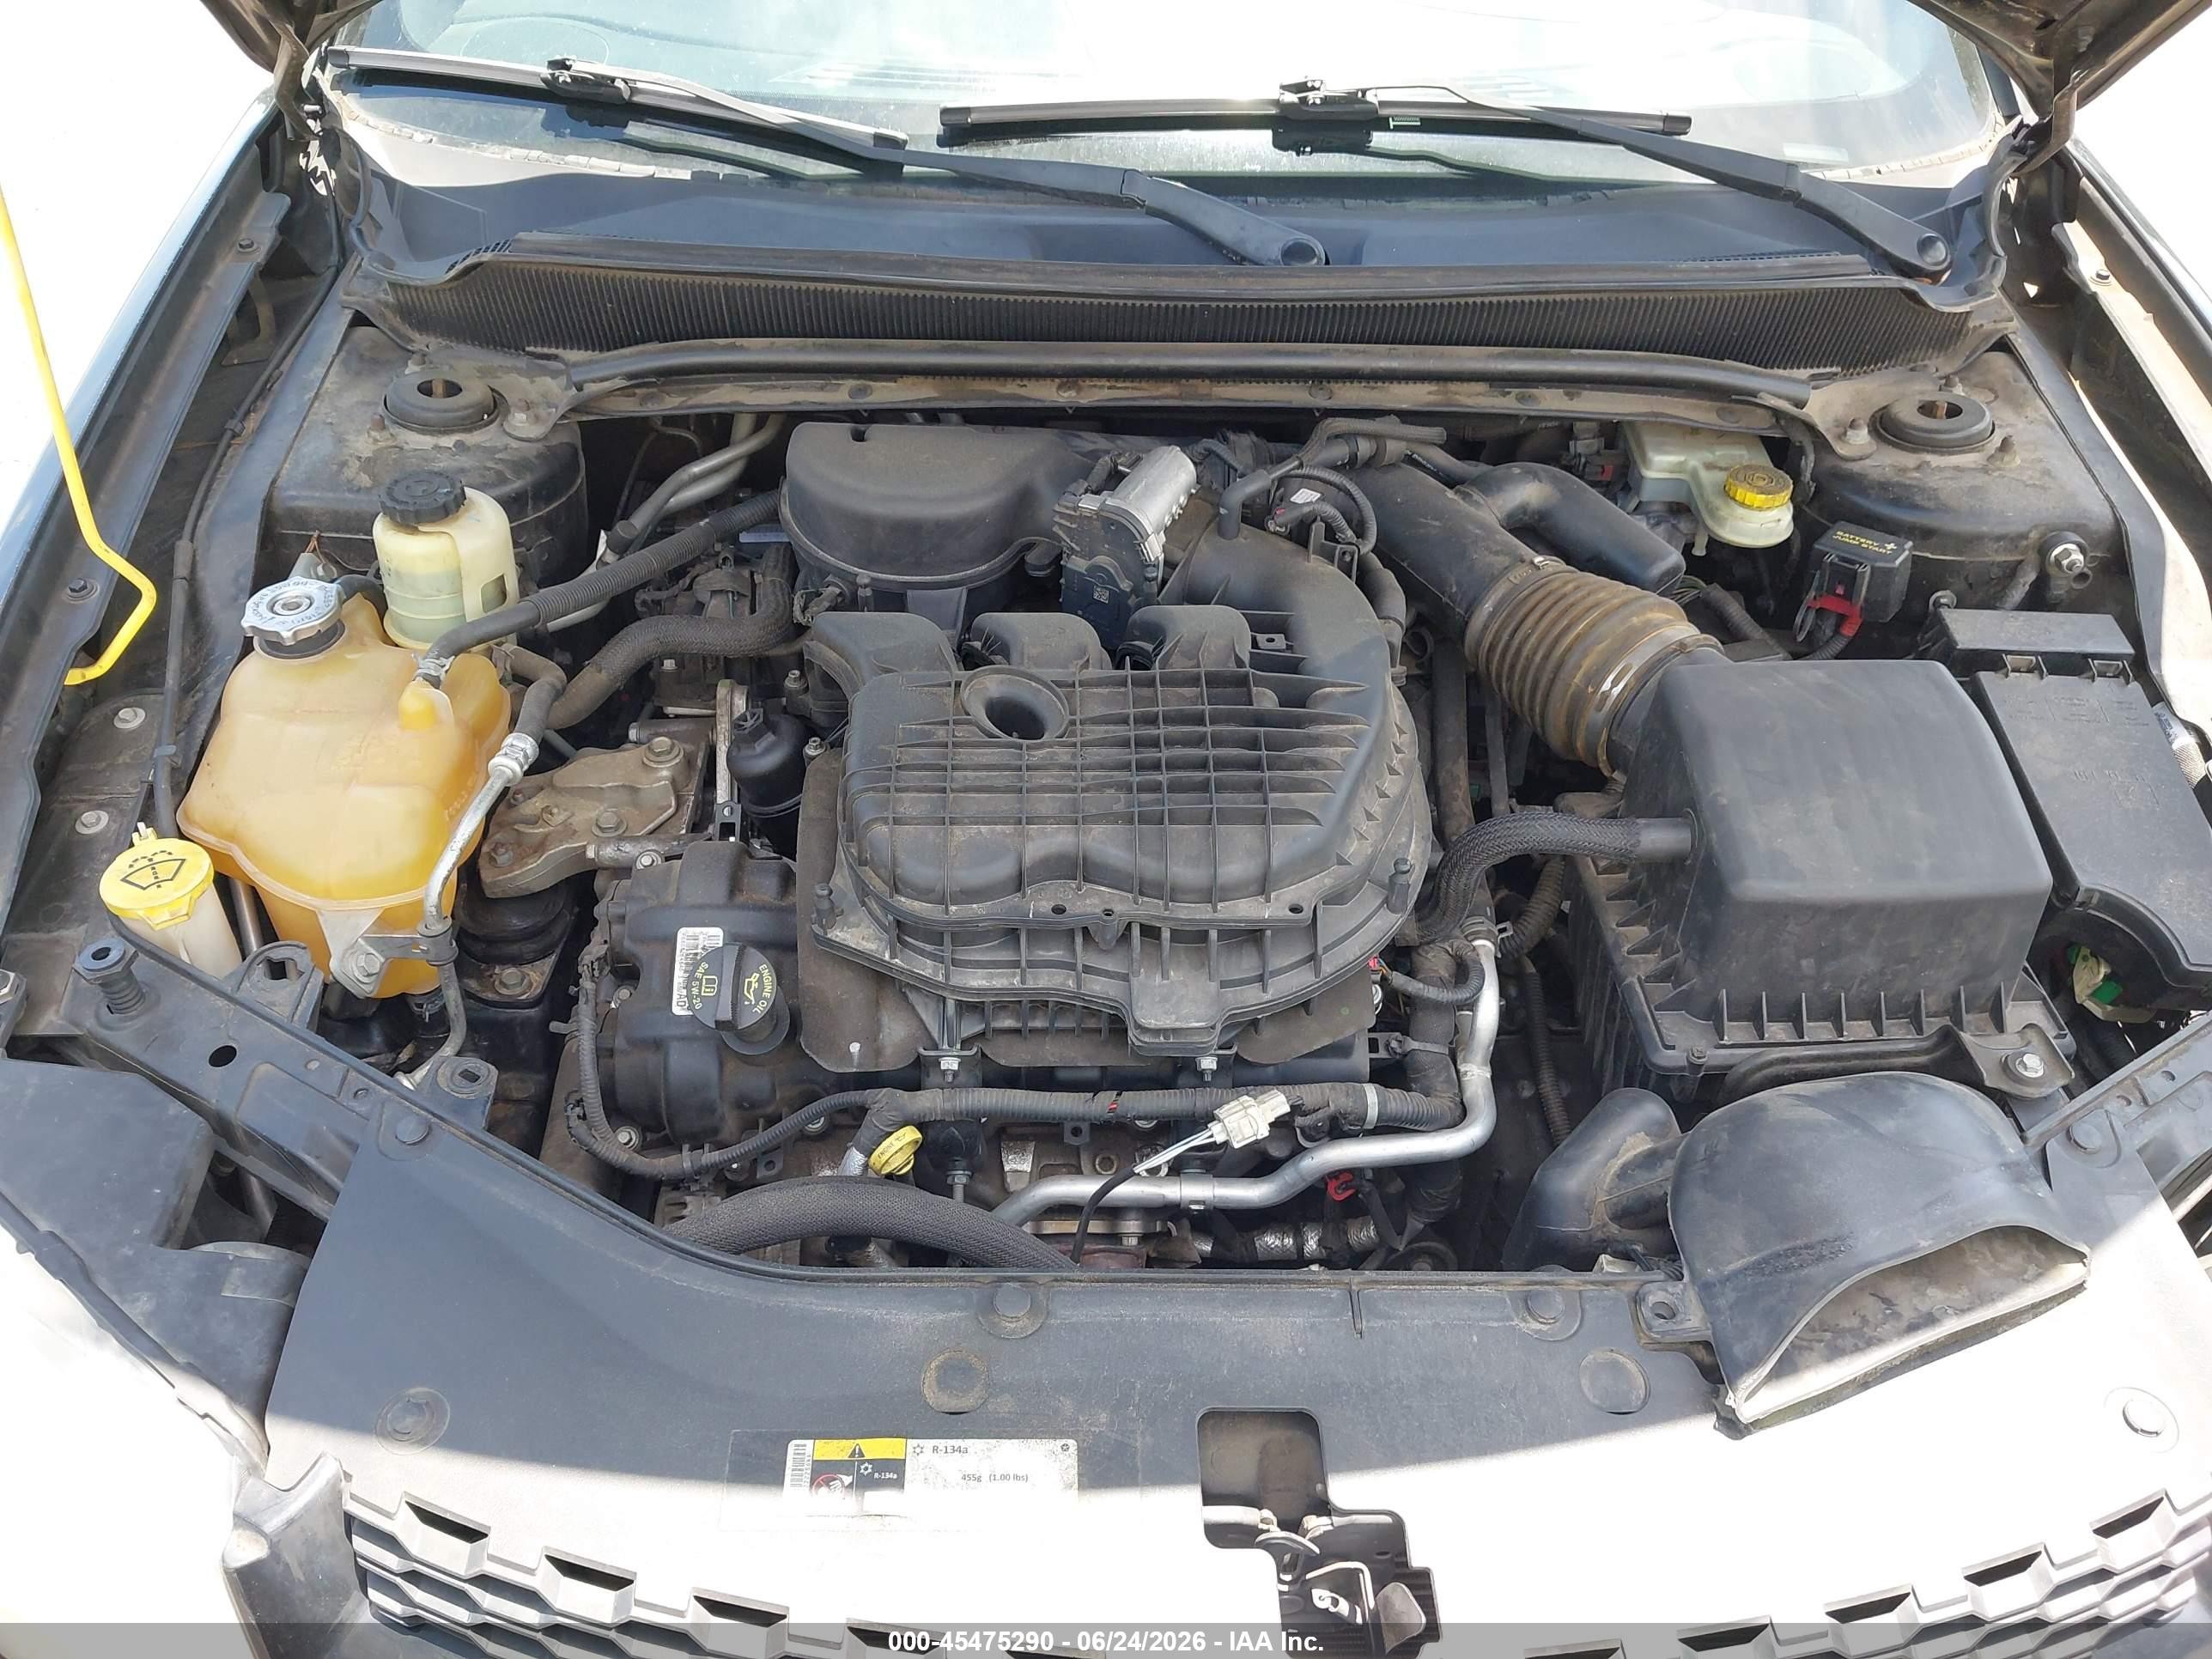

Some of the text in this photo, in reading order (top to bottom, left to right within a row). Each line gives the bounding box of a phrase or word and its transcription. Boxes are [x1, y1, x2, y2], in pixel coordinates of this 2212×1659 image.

[1836, 531, 1880, 546] BATTERY
[691, 962, 708, 1010] SAE 5W-20
[752, 963, 772, 1013] ENGINE OIL
[932, 1445, 969, 1454] R-134a
[961, 1474, 1029, 1482] 455g (1.00 lbs)
